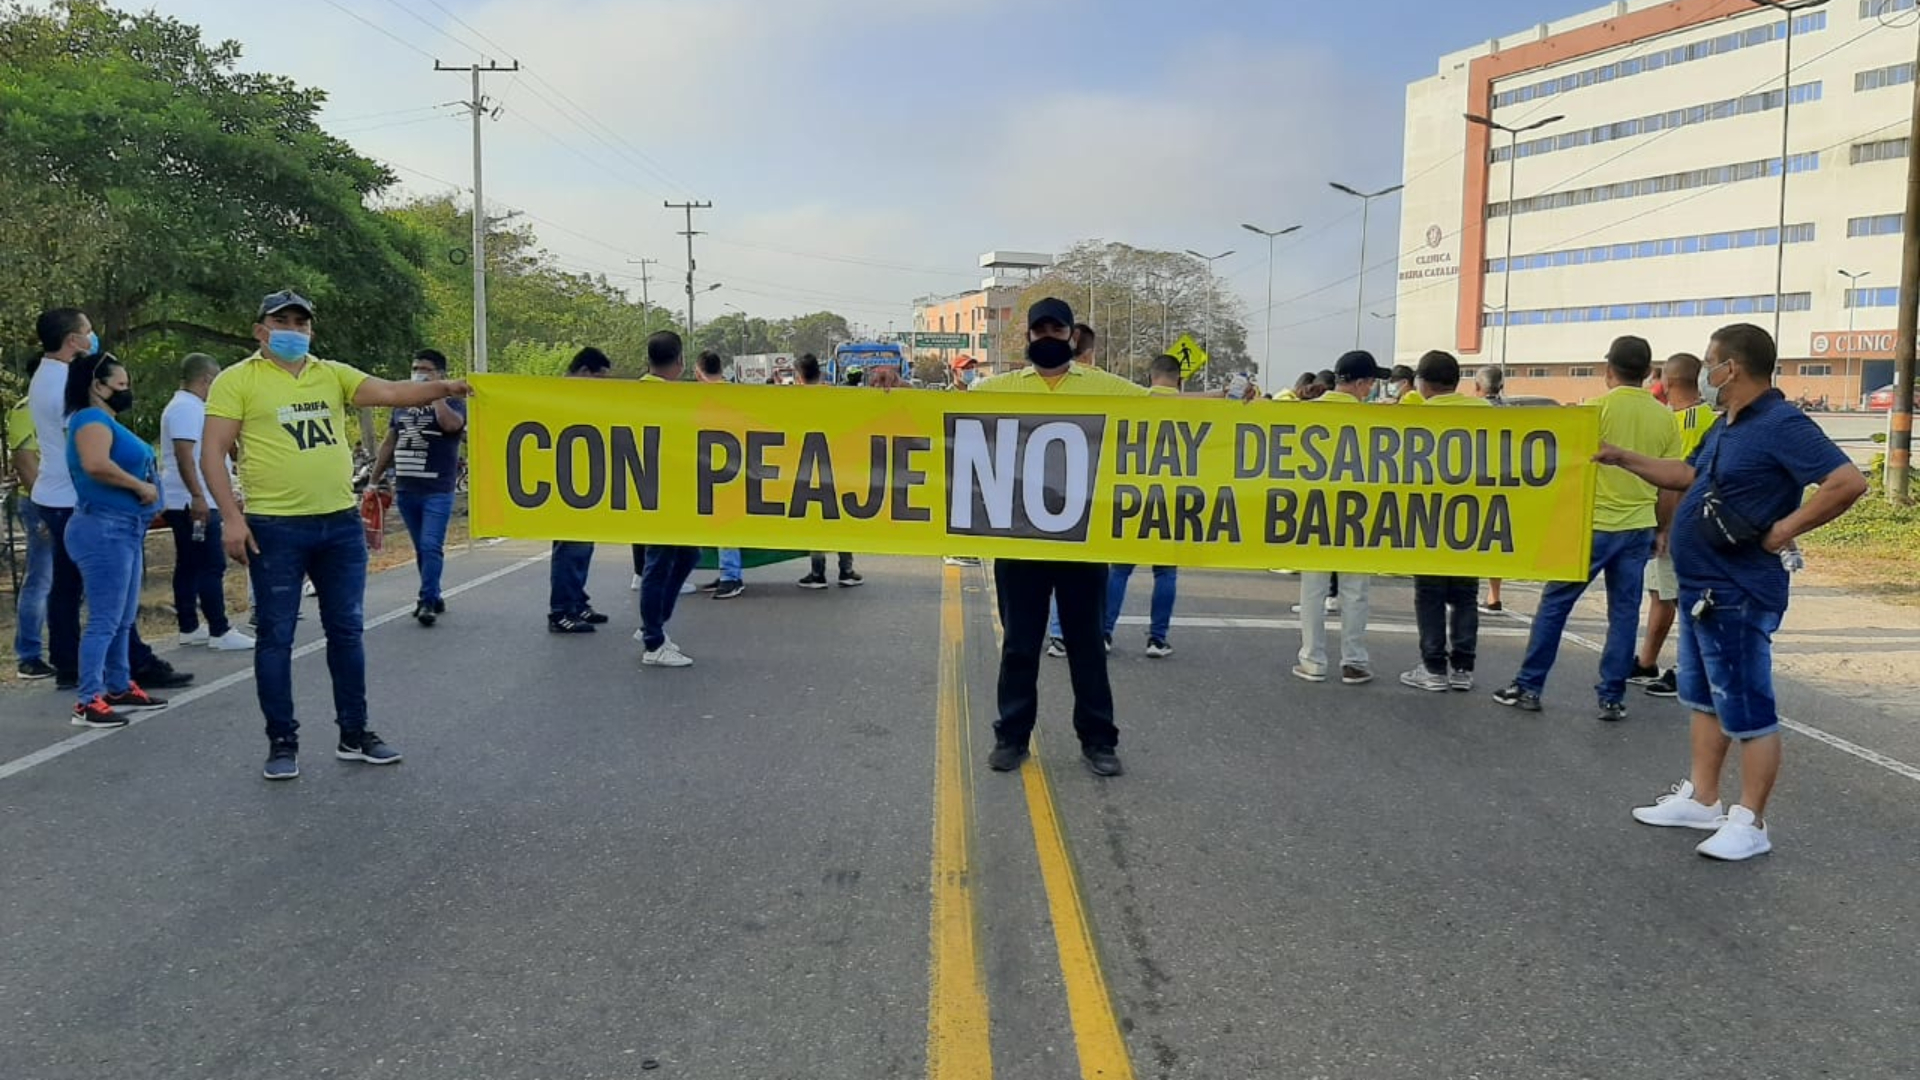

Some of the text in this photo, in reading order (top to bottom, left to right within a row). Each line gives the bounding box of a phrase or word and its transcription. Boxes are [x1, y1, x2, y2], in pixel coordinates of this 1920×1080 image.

[1836, 334, 1897, 352] CLINIC
[290, 400, 329, 412] TARIFA
[281, 418, 337, 450] YA!
[1115, 419, 1558, 487] HAY DESARROLLO
[506, 417, 1090, 536] CON PEAJE NO
[1111, 484, 1514, 554] PARA BARANOA
